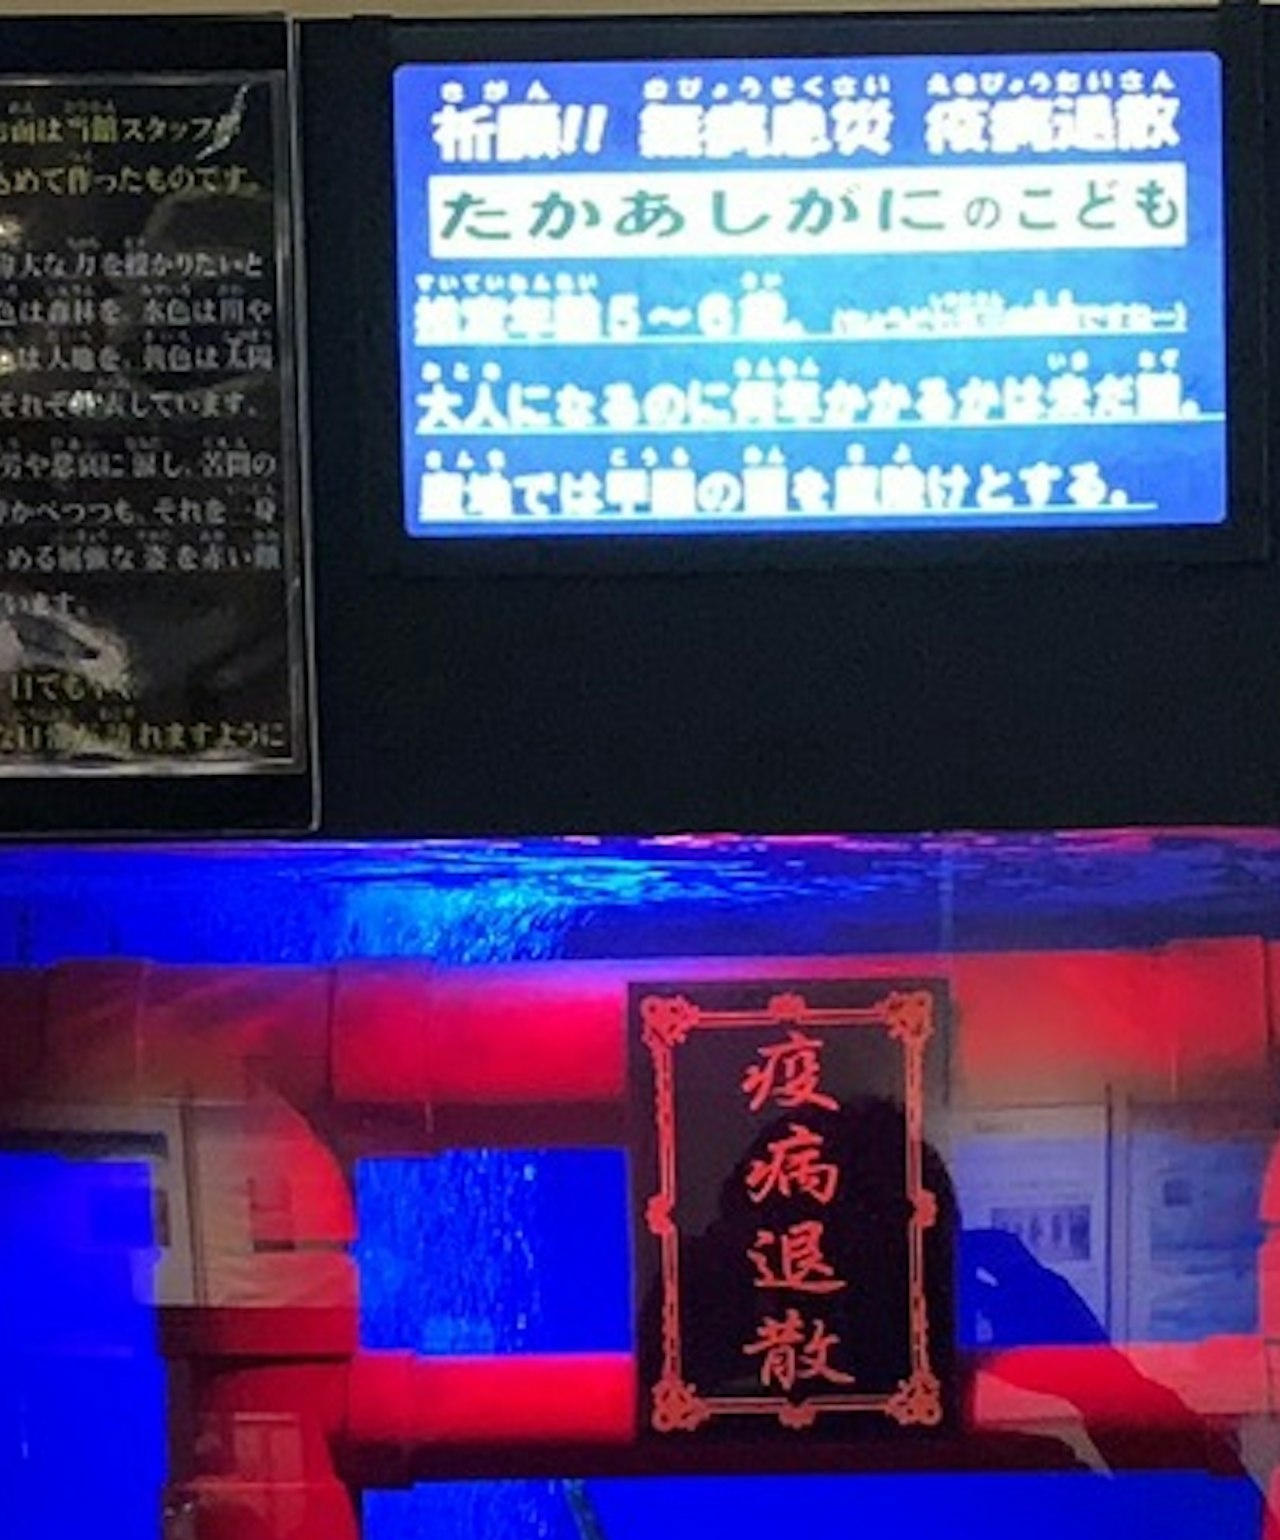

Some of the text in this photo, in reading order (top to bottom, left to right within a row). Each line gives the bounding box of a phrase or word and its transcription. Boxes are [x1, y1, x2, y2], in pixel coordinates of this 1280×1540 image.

[440, 178, 1179, 241] たかあしがにのこども
[742, 1029, 856, 1391] 疫病退散
